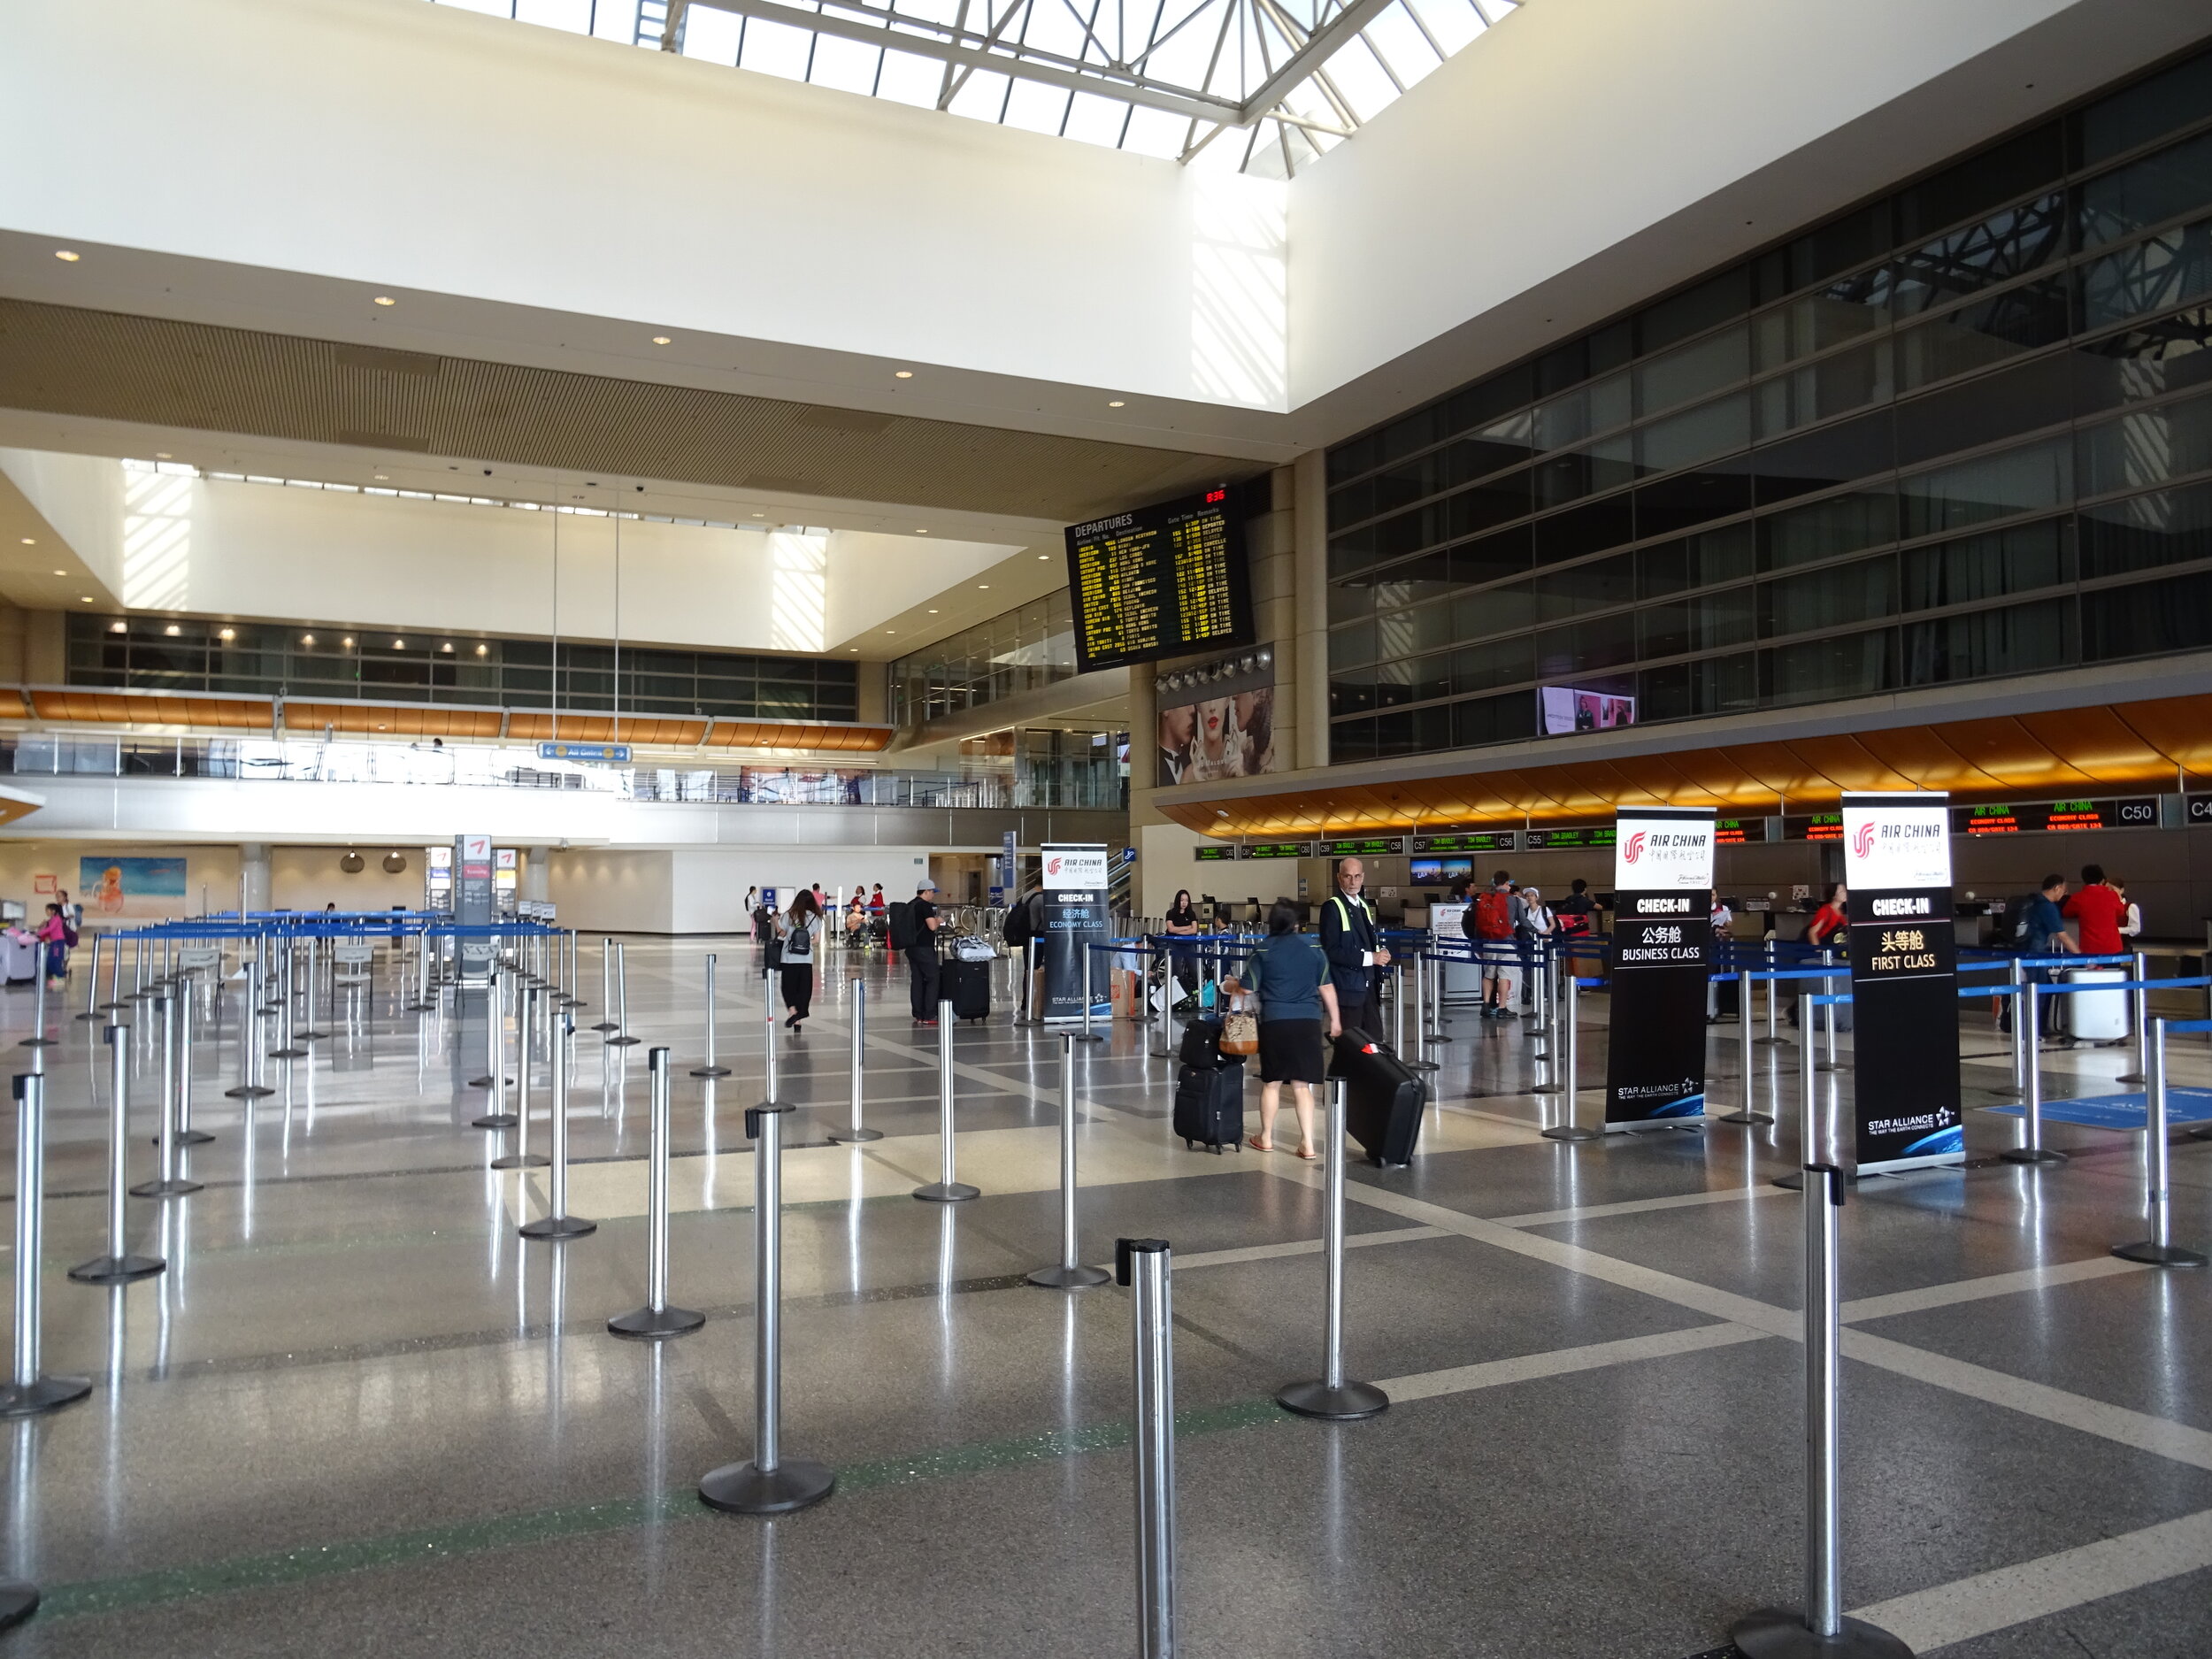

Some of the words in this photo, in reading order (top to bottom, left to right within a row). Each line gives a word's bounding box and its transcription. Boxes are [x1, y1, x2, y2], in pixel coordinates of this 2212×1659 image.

[1206, 490, 1225, 503] 8:36
[1075, 514, 1133, 538] DEPARTURES
[1115, 525, 1142, 536] Destination
[1181, 513, 1193, 521] Time
[1197, 506, 1219, 517] Remarks
[1974, 807, 1986, 816] AIR
[1989, 806, 2009, 815] CHINA
[2054, 803, 2066, 812] AIR
[2070, 801, 2092, 811] CHINA
[2121, 806, 2151, 820] C50
[1881, 825, 1901, 838] AIR
[1904, 824, 1940, 838] CHINA
[1500, 838, 1512, 846] C56
[1527, 836, 1541, 844] C55
[1650, 835, 1670, 847] AIR
[1672, 835, 1706, 847] CHINA
[1058, 894, 1094, 902] CHECK-IN
[1637, 898, 1690, 913] CHECK-IN
[1872, 898, 1929, 916] CHECK-IN
[1062, 909, 1090, 919] 经济舱
[1642, 926, 1681, 944] 公务舱
[1881, 930, 1924, 952] 头等舱
[1622, 948, 1668, 961] BUSINESS
[1671, 947, 1699, 959] CLASS
[1872, 956, 1901, 970] FIRST
[1904, 954, 1935, 968] CLASS
[1618, 1087, 1638, 1096] STAR
[1640, 1084, 1679, 1093] ALLIANCE
[1868, 1119, 1890, 1130] STAR
[1892, 1114, 1933, 1127] ALLIANCE
